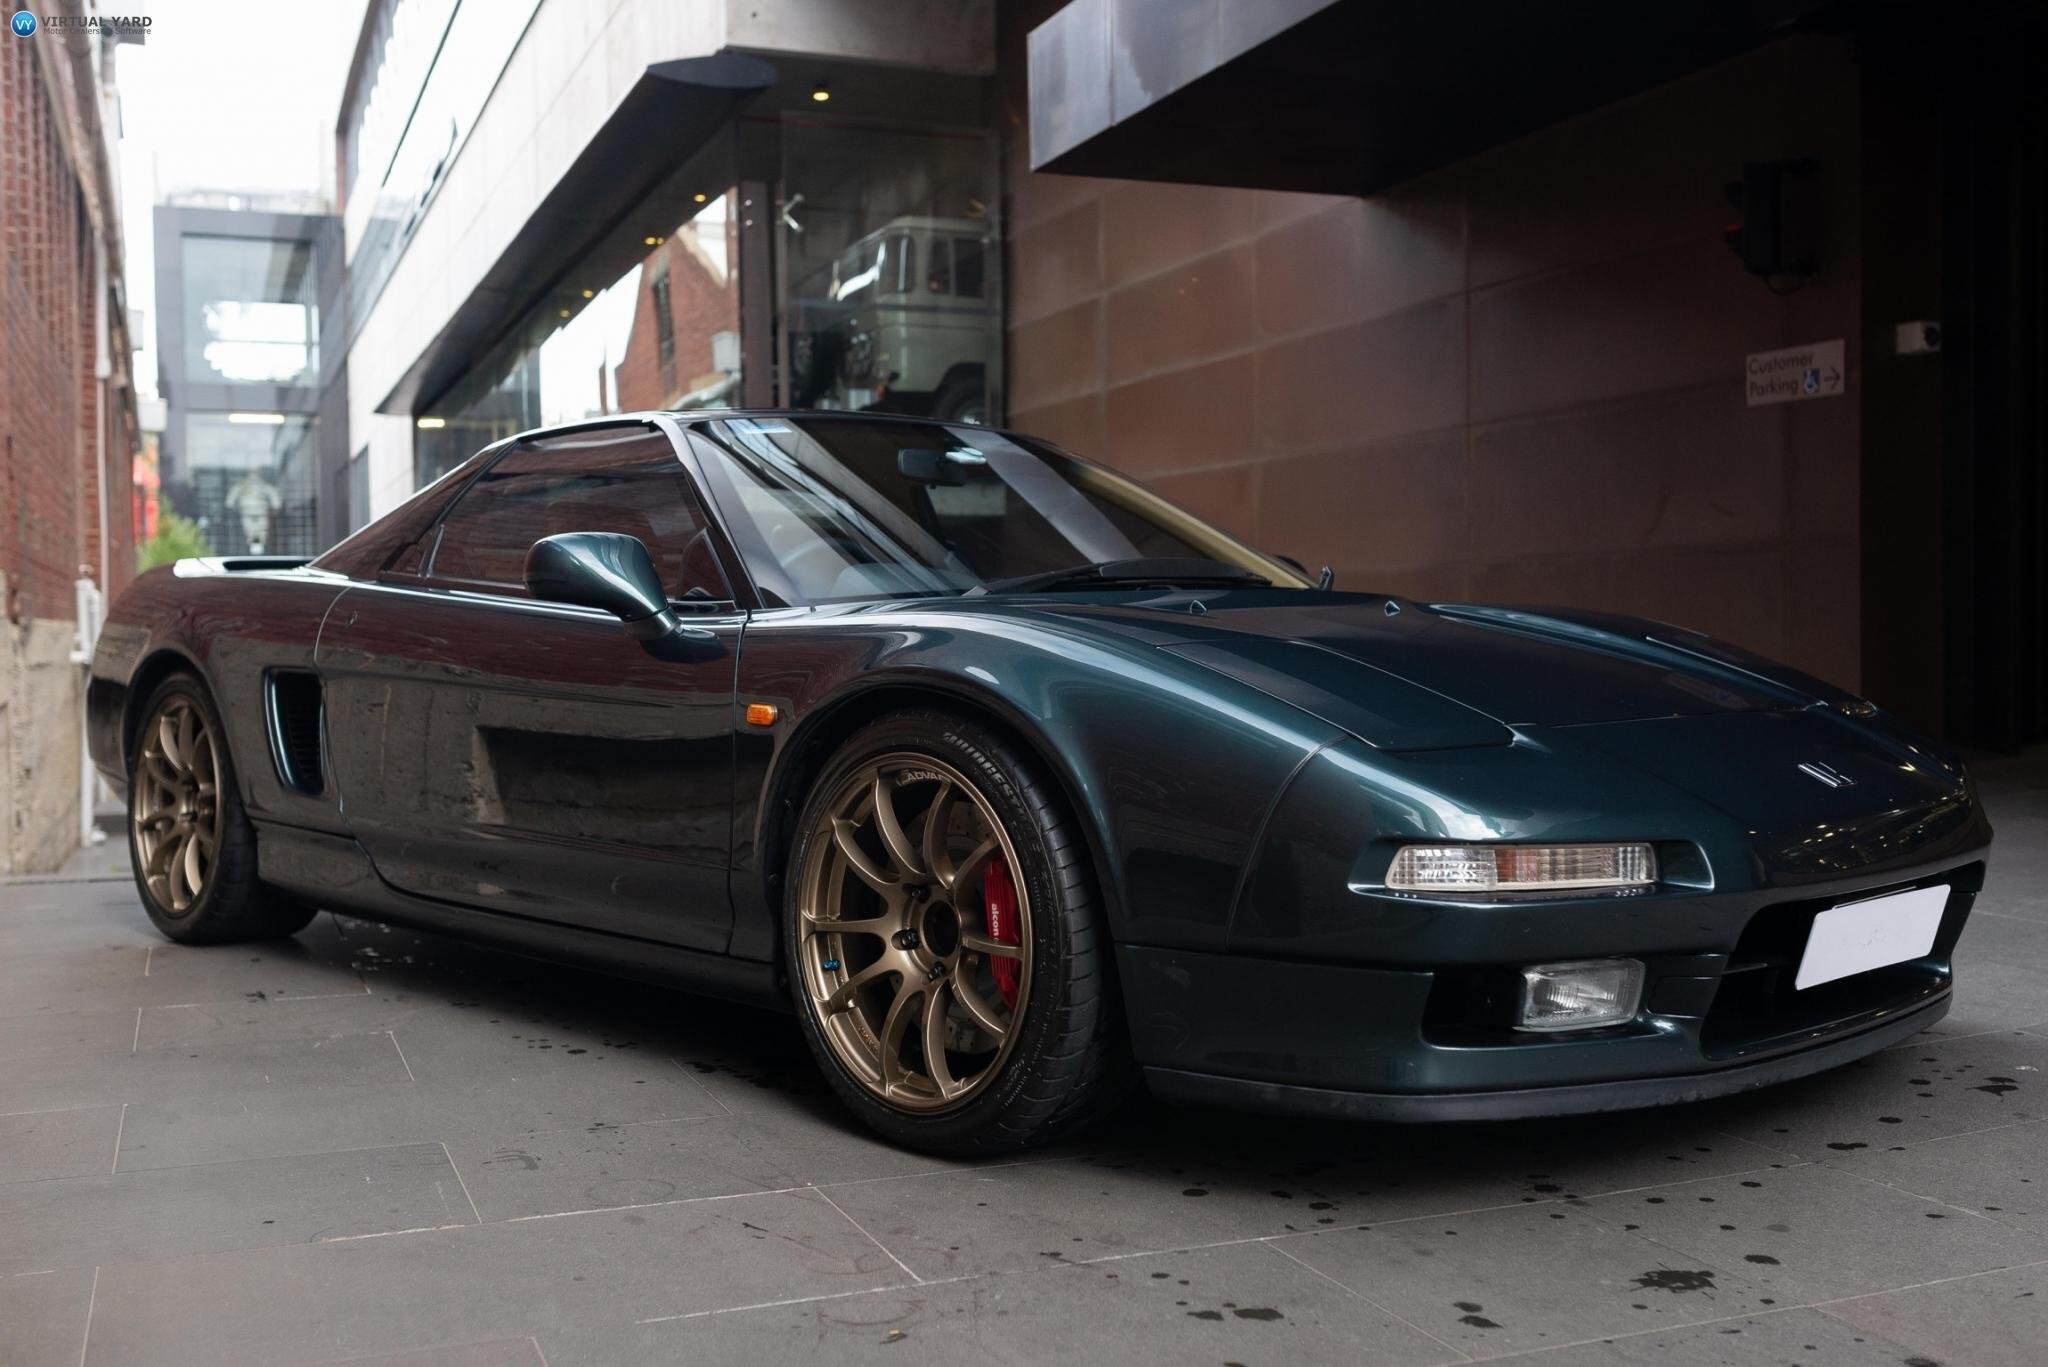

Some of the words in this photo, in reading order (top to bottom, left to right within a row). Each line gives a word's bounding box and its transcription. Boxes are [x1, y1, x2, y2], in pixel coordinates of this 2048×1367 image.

[1748, 354, 1814, 374] Customer
[1749, 375, 1799, 398] Parking
[991, 902, 1000, 937] alcon
